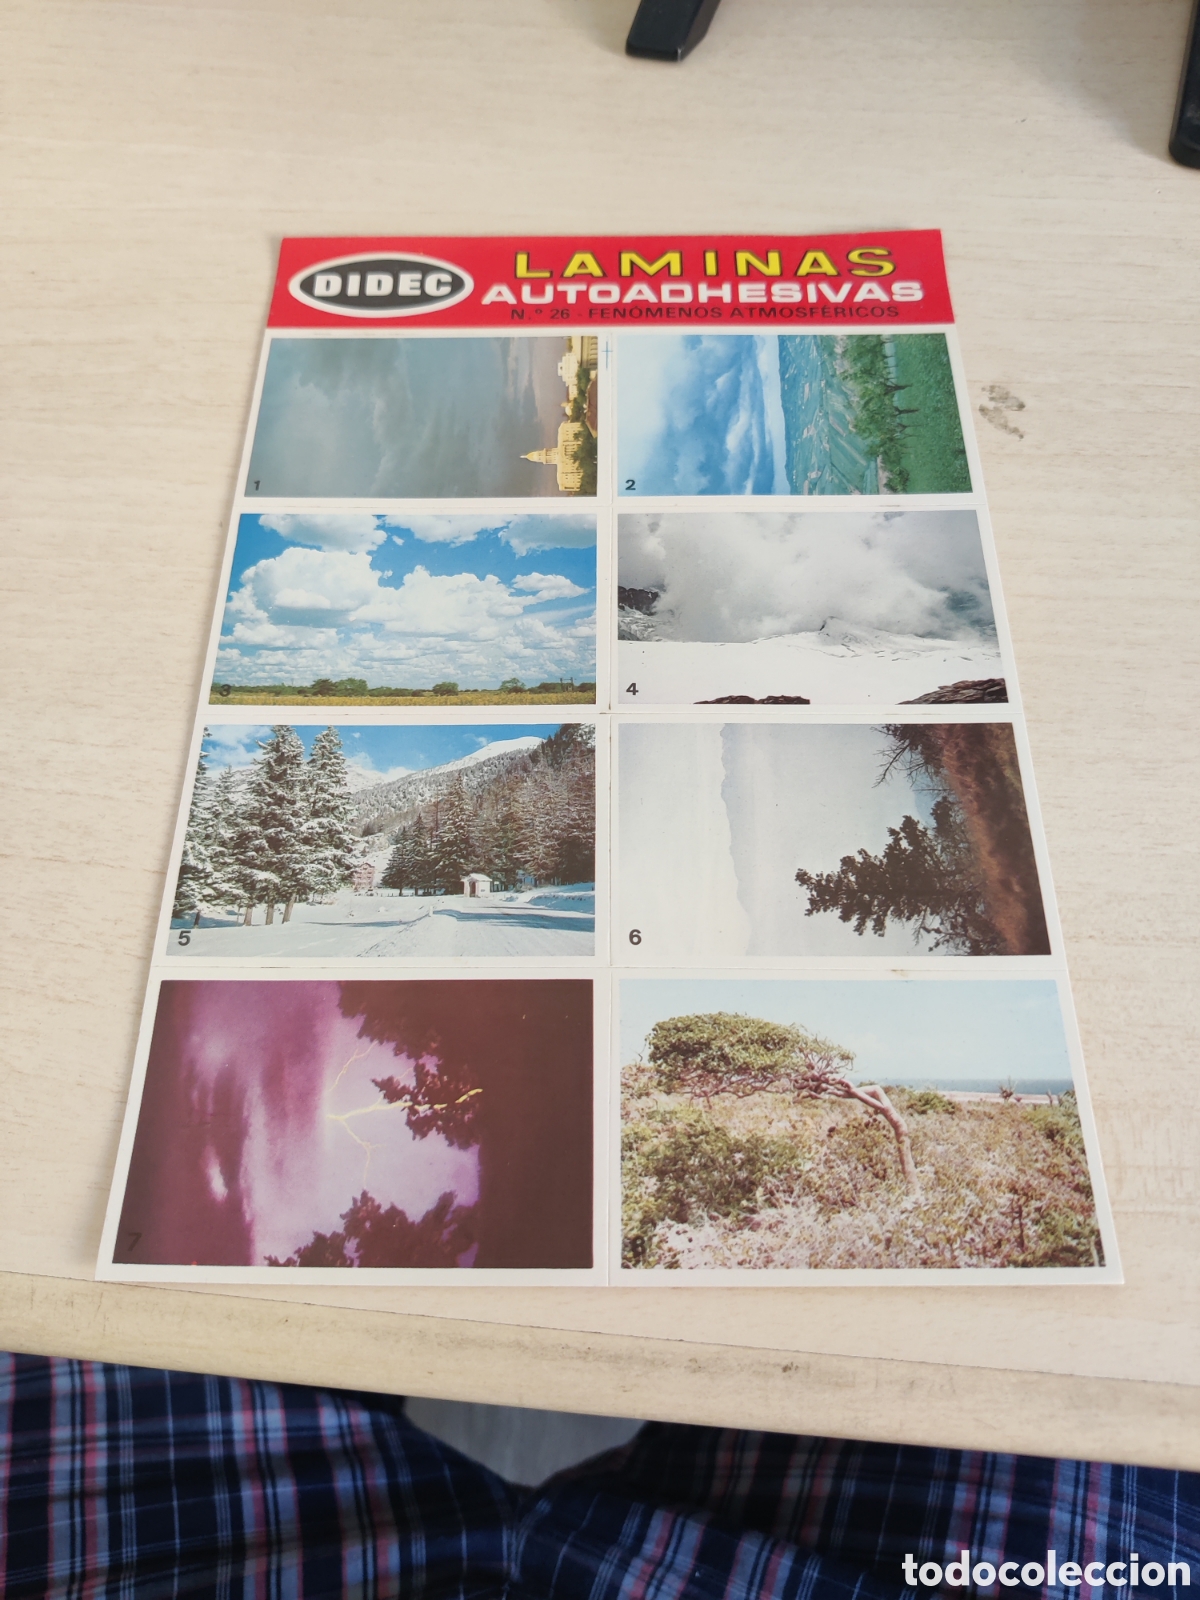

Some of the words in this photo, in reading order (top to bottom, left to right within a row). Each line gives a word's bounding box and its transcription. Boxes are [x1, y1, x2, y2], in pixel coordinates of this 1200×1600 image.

[515, 247, 896, 279] LAMINAS
[312, 272, 453, 297] DIDEC
[481, 281, 923, 305] AUTOADHESIVAS
[549, 307, 571, 320] 26
[588, 305, 723, 319] FENÓMENOS
[729, 304, 899, 319] ATMOSFÉRICOS
[253, 480, 261, 491] 1
[625, 479, 636, 491] 2
[218, 684, 232, 698] 3
[626, 682, 639, 696] 4
[178, 930, 192, 947] 5
[629, 929, 642, 946] 6
[128, 1233, 143, 1252] 7
